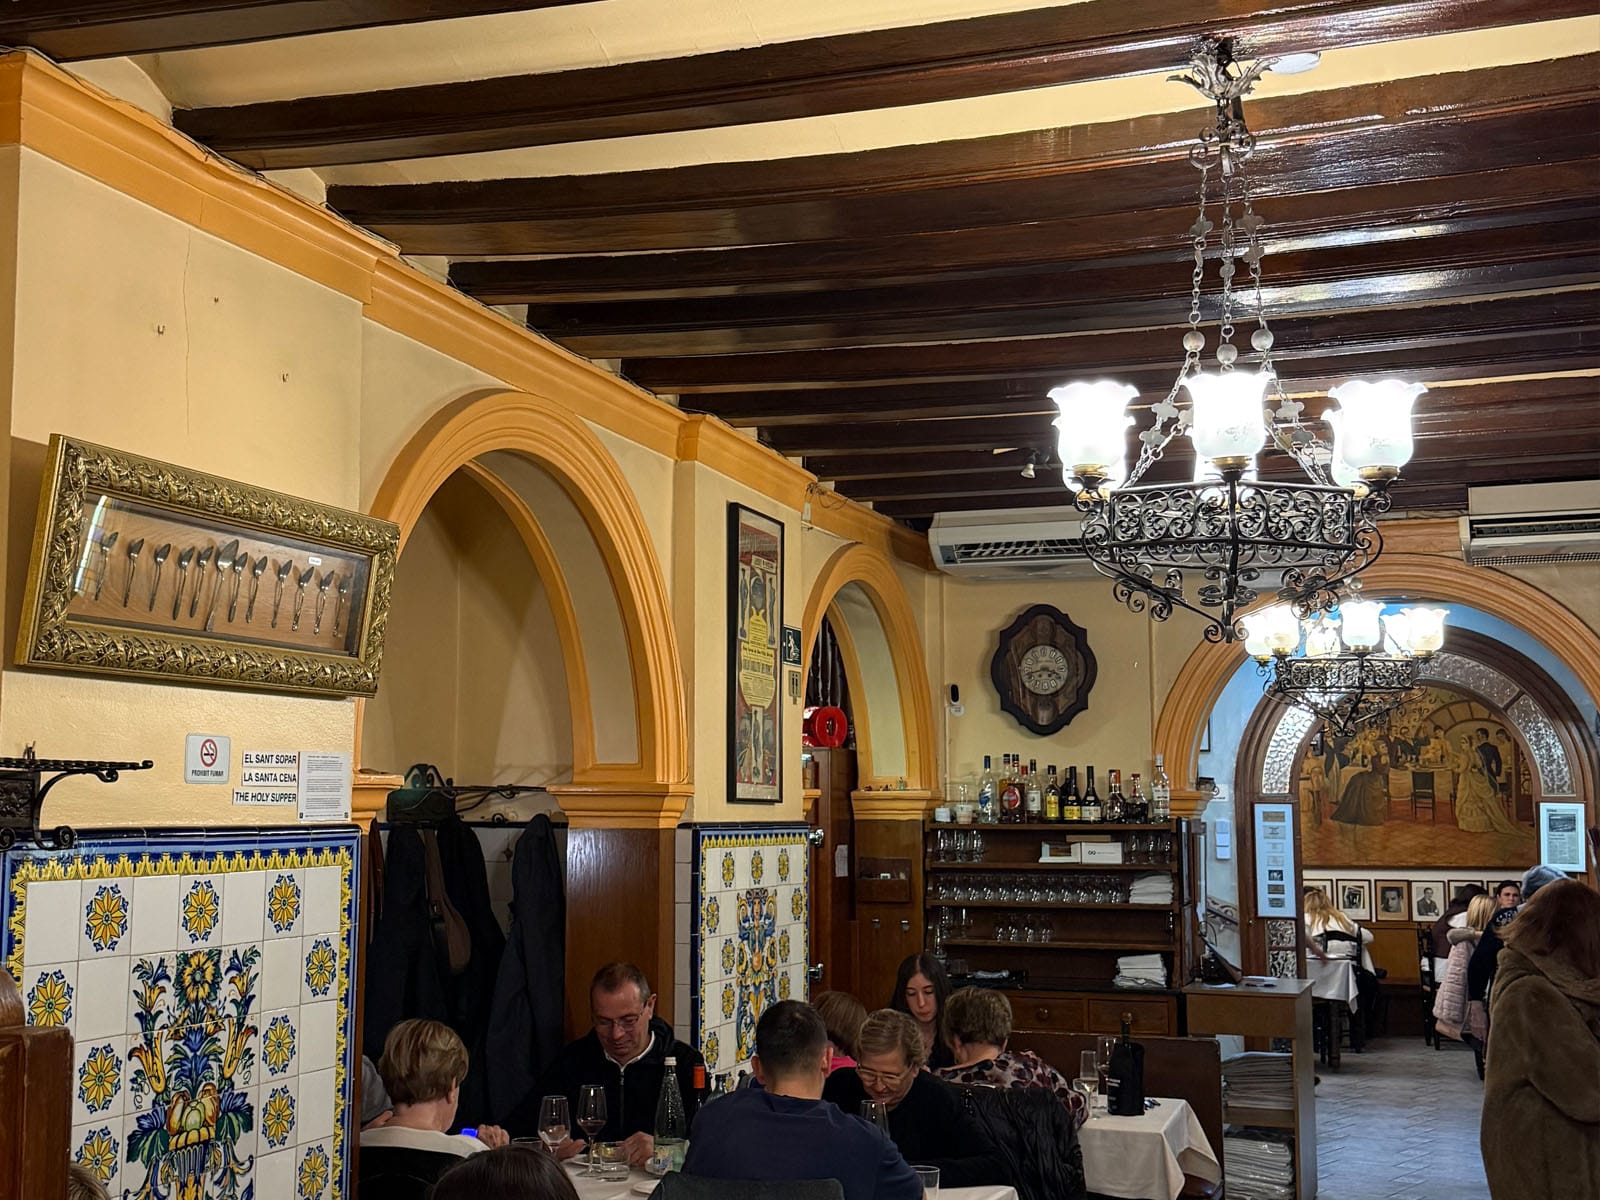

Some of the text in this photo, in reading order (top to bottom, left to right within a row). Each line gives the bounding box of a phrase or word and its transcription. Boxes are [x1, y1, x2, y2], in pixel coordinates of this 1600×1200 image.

[244, 754, 254, 764] EL
[255, 754, 274, 764] SANT
[275, 754, 297, 765] SOPAR
[191, 769, 209, 777] PROHIBIT
[243, 772, 297, 782] LA SANTA CENA
[235, 791, 297, 803] THE HOLY SUPPER
